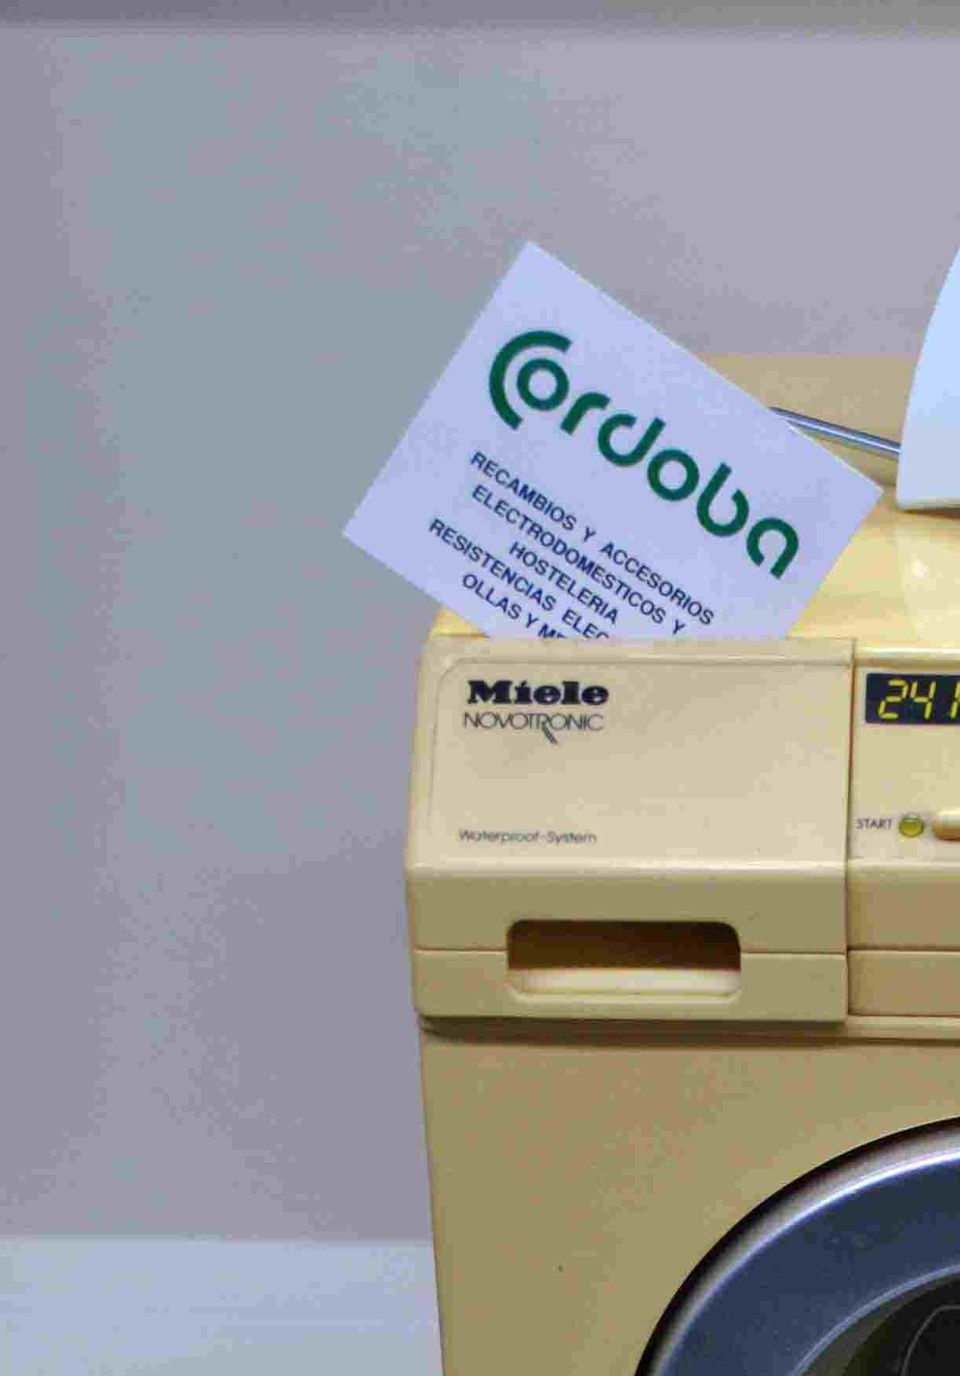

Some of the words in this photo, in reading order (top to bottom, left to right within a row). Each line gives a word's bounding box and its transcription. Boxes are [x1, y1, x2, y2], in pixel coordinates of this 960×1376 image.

[489, 330, 800, 579] Cordoba
[429, 518, 557, 612] RESISTENCIAS
[470, 451, 577, 531] RECAMBIOS
[582, 526, 597, 542] Y
[600, 541, 715, 625] ACCESORIOS
[472, 484, 667, 625] ELECTRODOMESTICOS
[671, 618, 686, 636] Y
[462, 573, 523, 620] OLLAS
[525, 612, 540, 629] Y
[537, 622, 567, 639] M
[509, 541, 619, 624] HOSTELERIA
[463, 712, 605, 745] NOVOTRONIC
[466, 680, 609, 706] Miele
[855, 818, 893, 832] START
